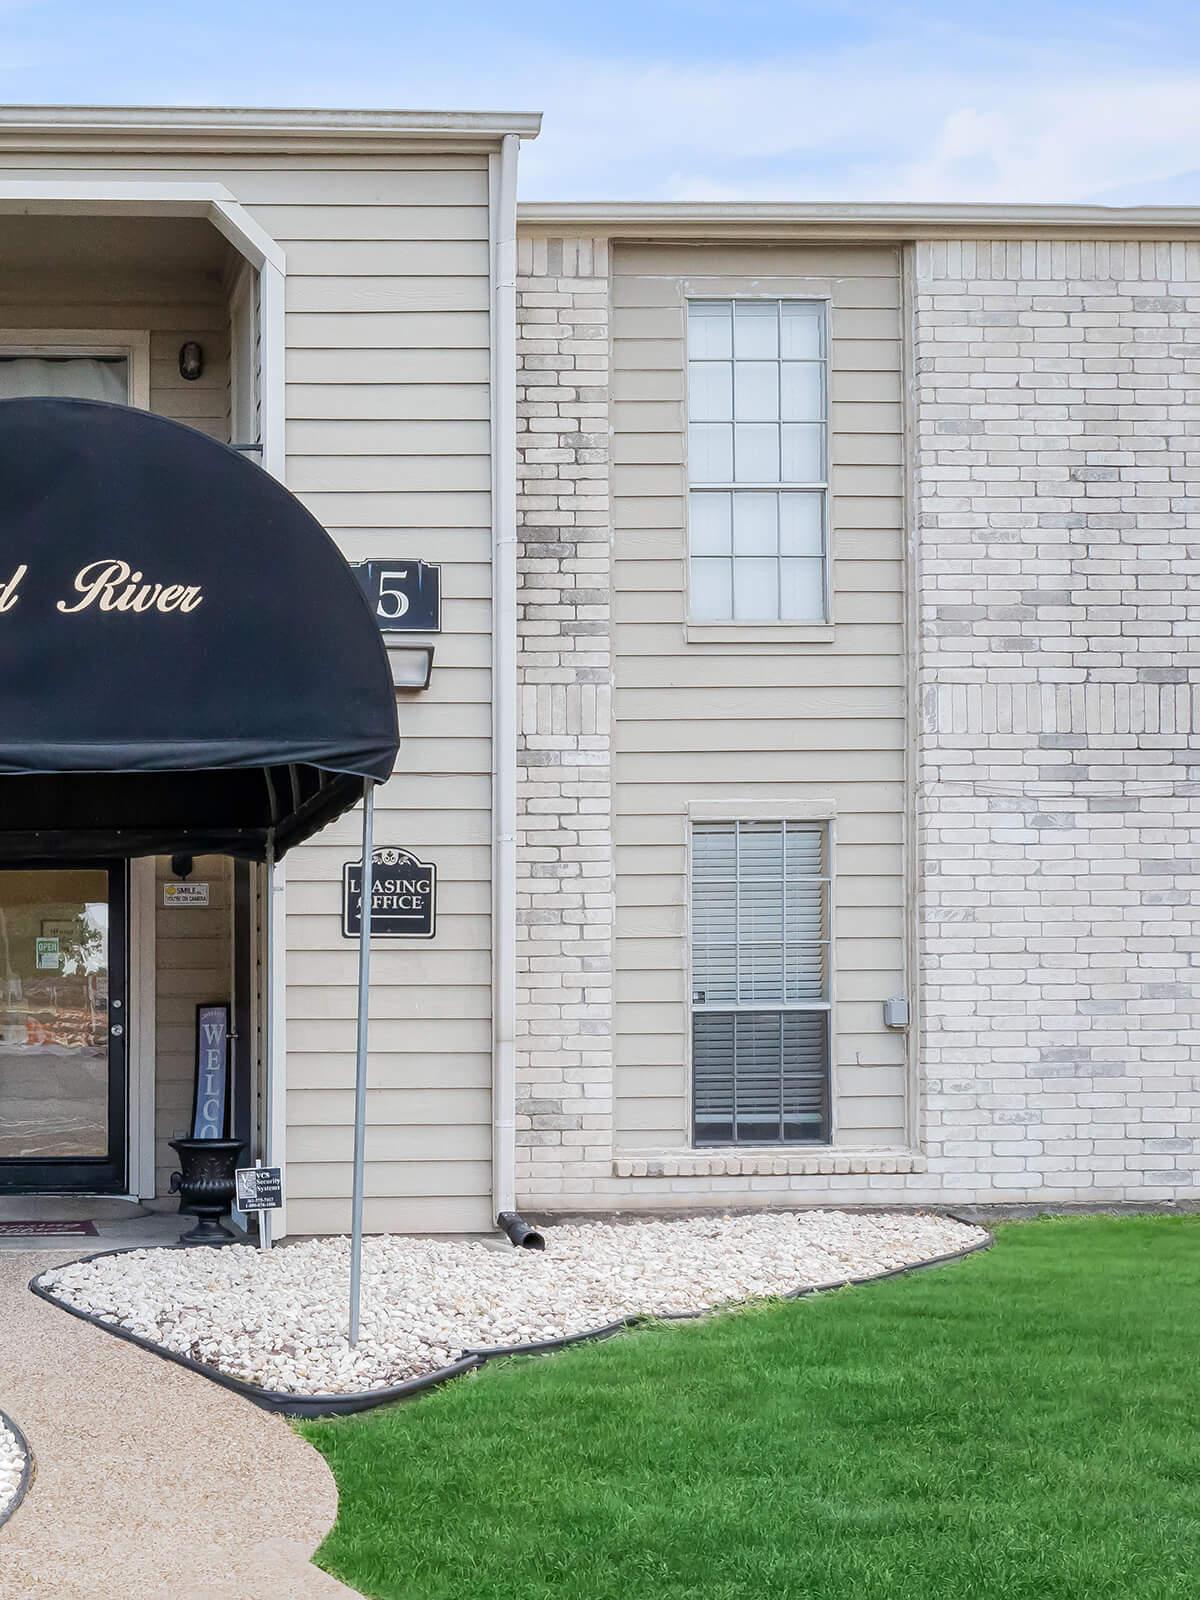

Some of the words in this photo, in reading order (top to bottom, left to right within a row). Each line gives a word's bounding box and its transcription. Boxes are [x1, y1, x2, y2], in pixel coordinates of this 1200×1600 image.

[56, 559, 203, 613] River
[376, 570, 409, 618] 5
[350, 879, 430, 894] LASING
[358, 895, 422, 909] FFICE
[38, 942, 57, 952] OPEN
